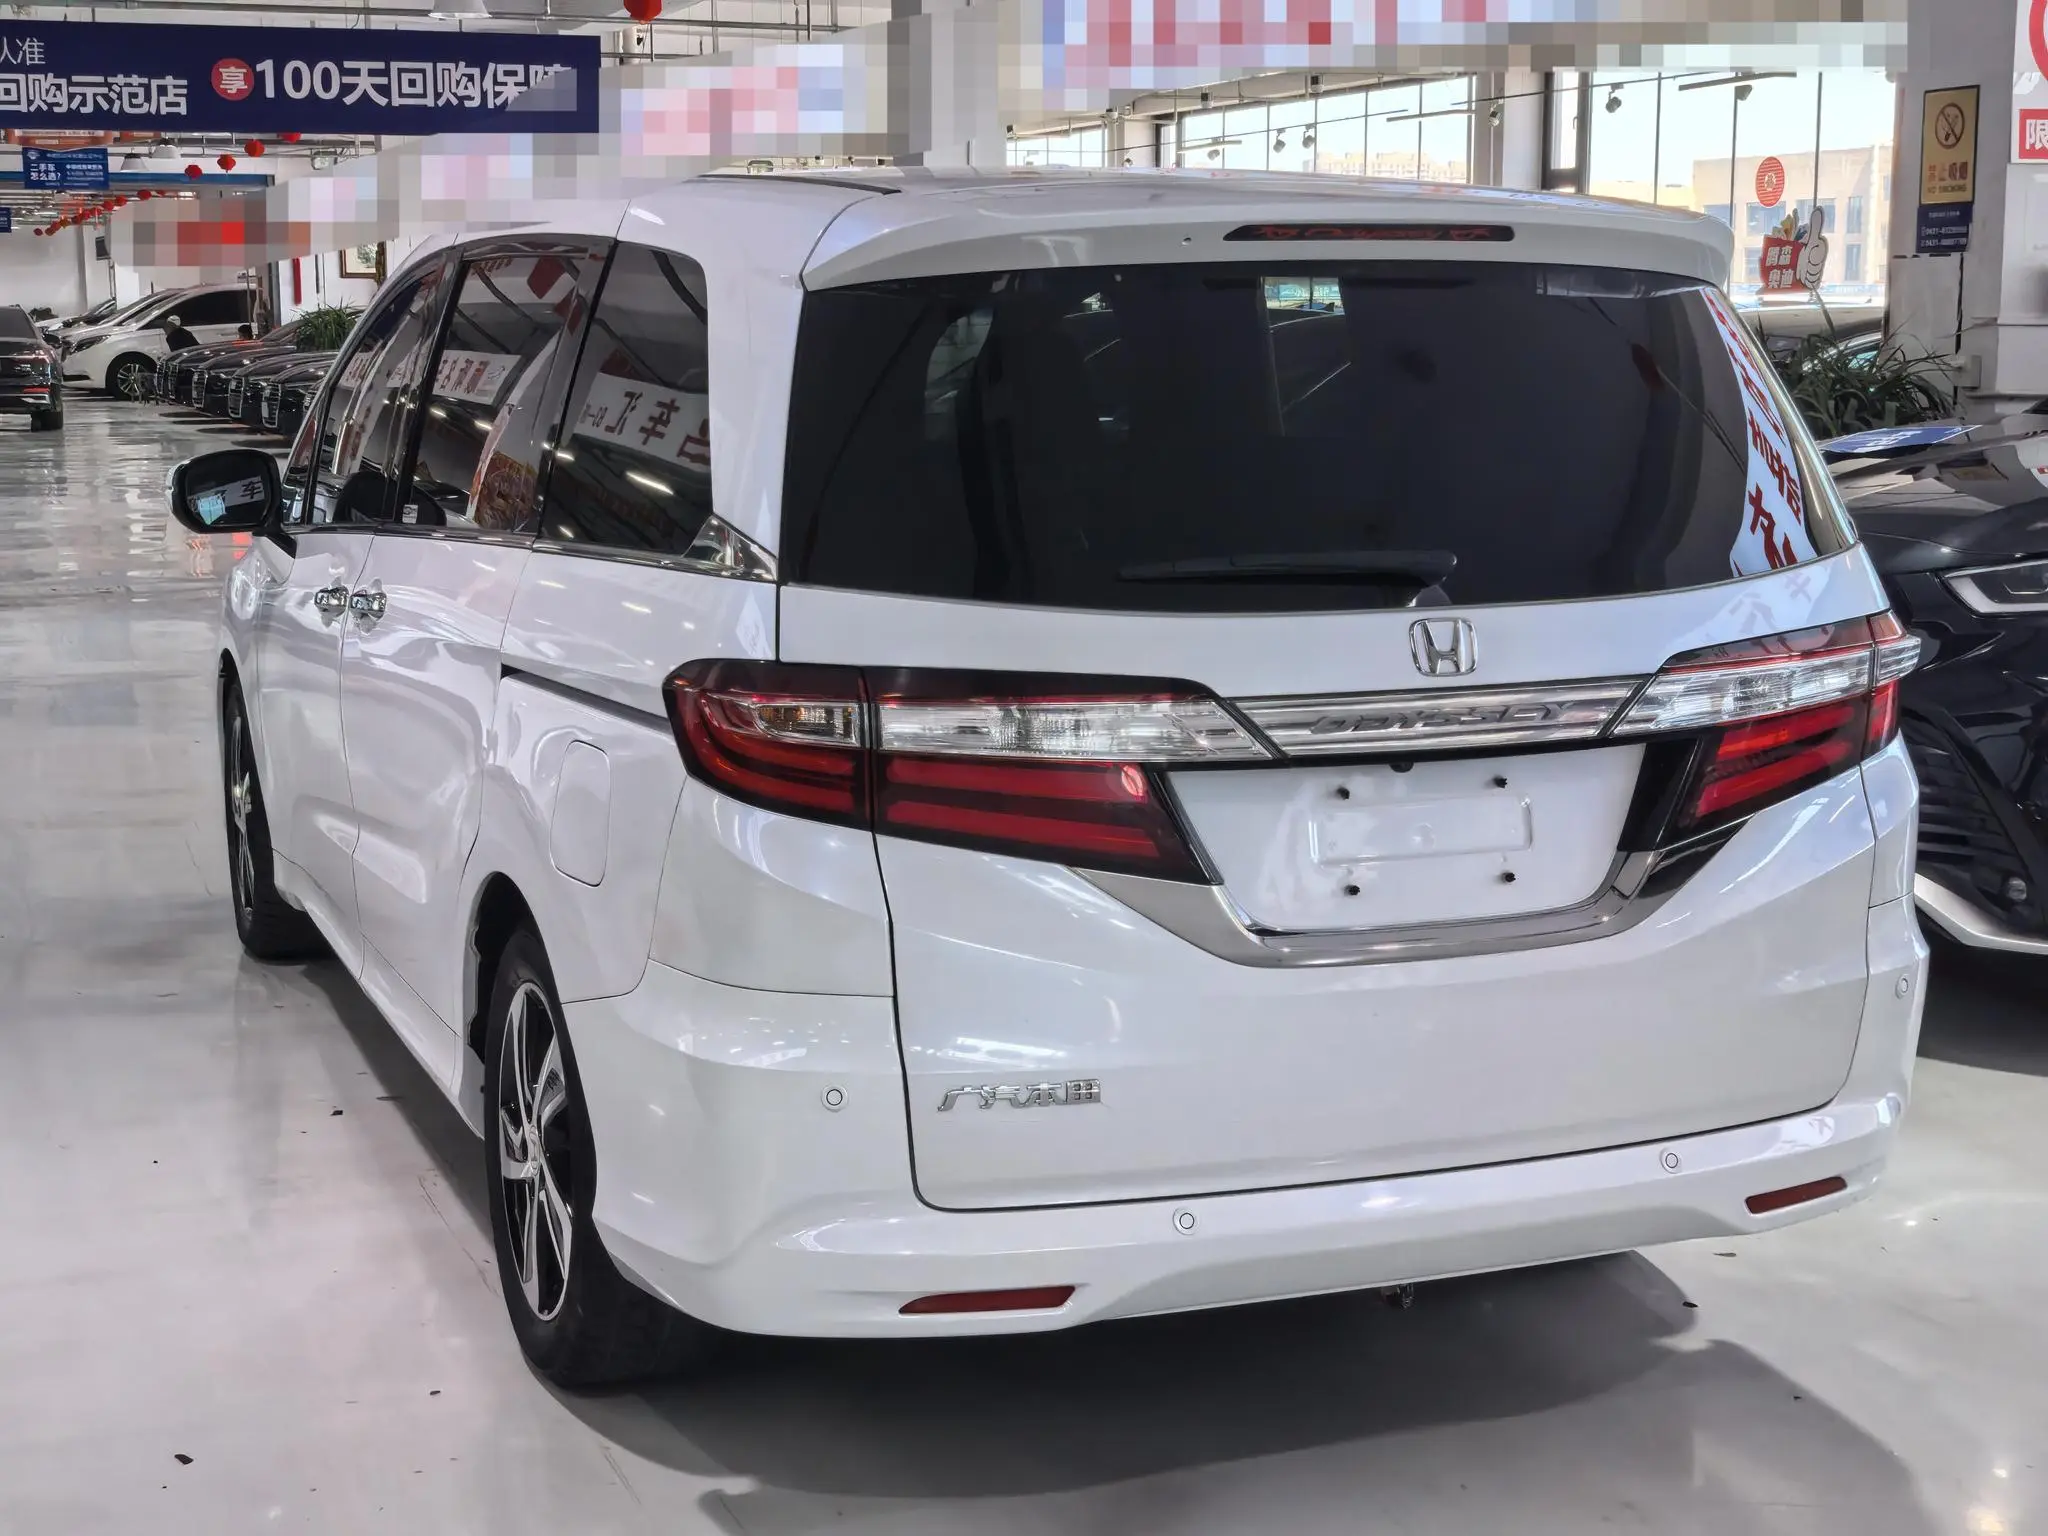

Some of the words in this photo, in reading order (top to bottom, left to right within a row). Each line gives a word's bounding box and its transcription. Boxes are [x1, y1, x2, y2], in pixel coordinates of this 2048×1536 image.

[0, 72, 188, 116] 回购示范店
[219, 66, 248, 94] 享
[1308, 702, 1574, 735] ODYSSEY
[938, 1078, 1101, 1112] 广汽本田
